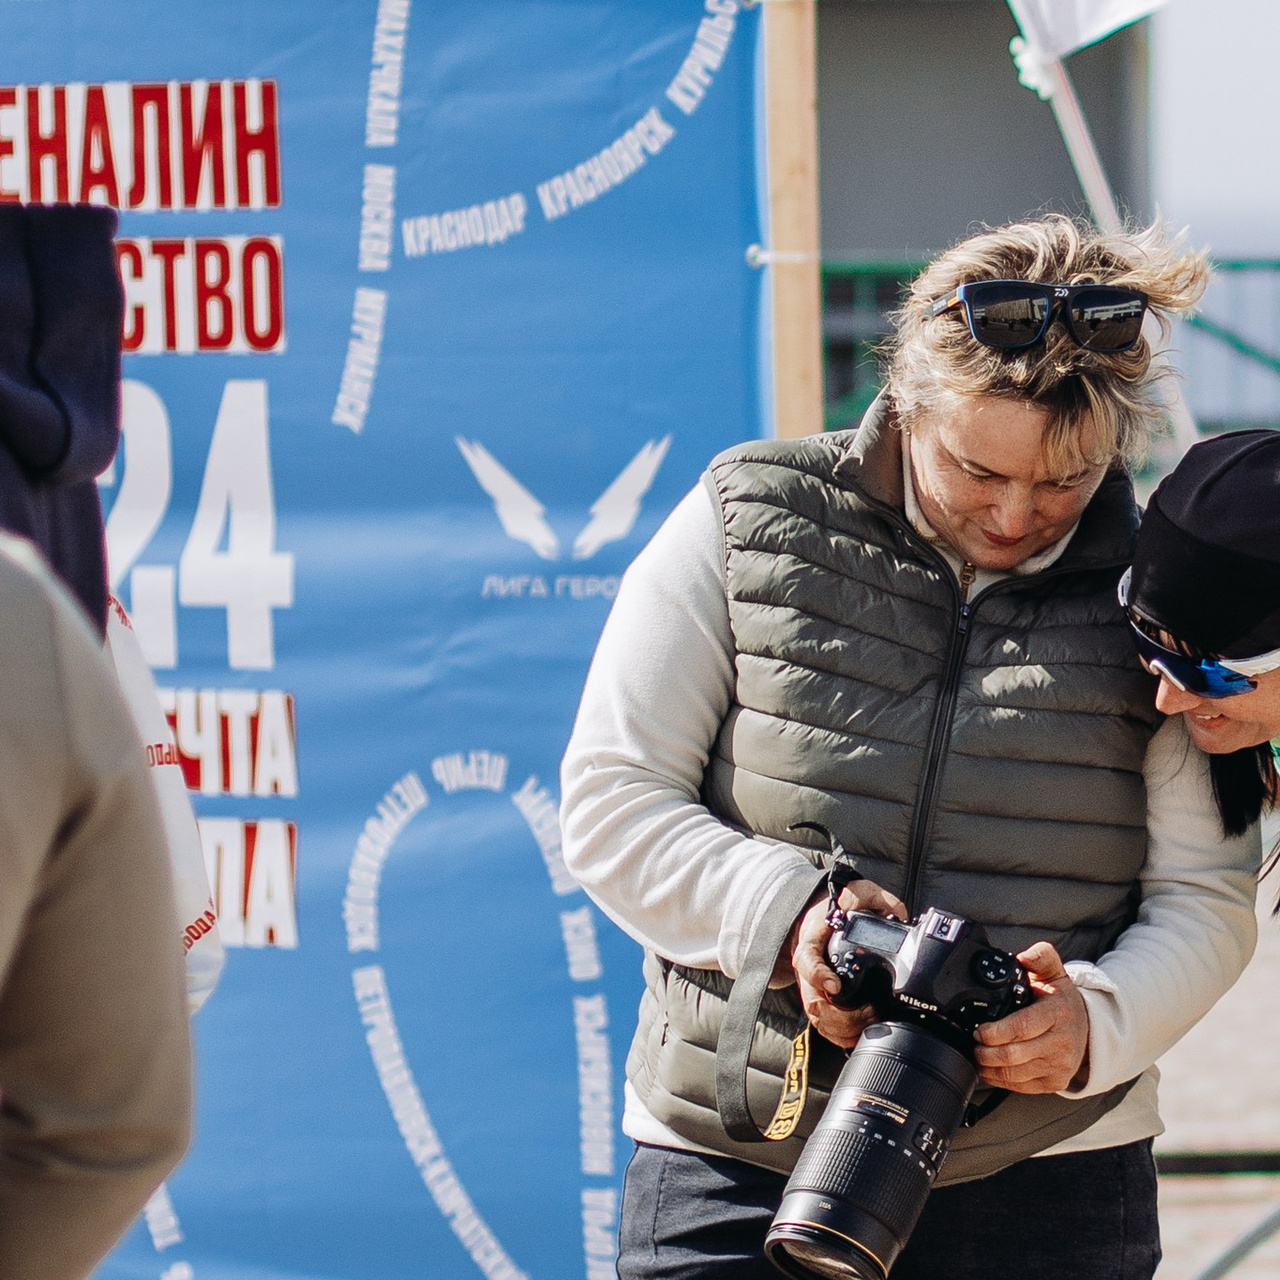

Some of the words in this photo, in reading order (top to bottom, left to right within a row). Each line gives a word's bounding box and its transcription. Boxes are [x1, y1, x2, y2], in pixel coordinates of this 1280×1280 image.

[536, 108, 676, 220] КРАСНОЯРСК
[358, 165, 396, 271] МОСКВА
[402, 192, 527, 257] КРАСНОДАР
[332, 288, 387, 434] МУРМАНСК
[481, 575, 547, 598] ЛИГА
[158, 690, 297, 795] ЧТА
[432, 751, 507, 793] ПЕРМЬ
[561, 906, 601, 981] ОМСК
[900, 994, 938, 1012] Nikon
[790, 1034, 805, 1093] Nikon
